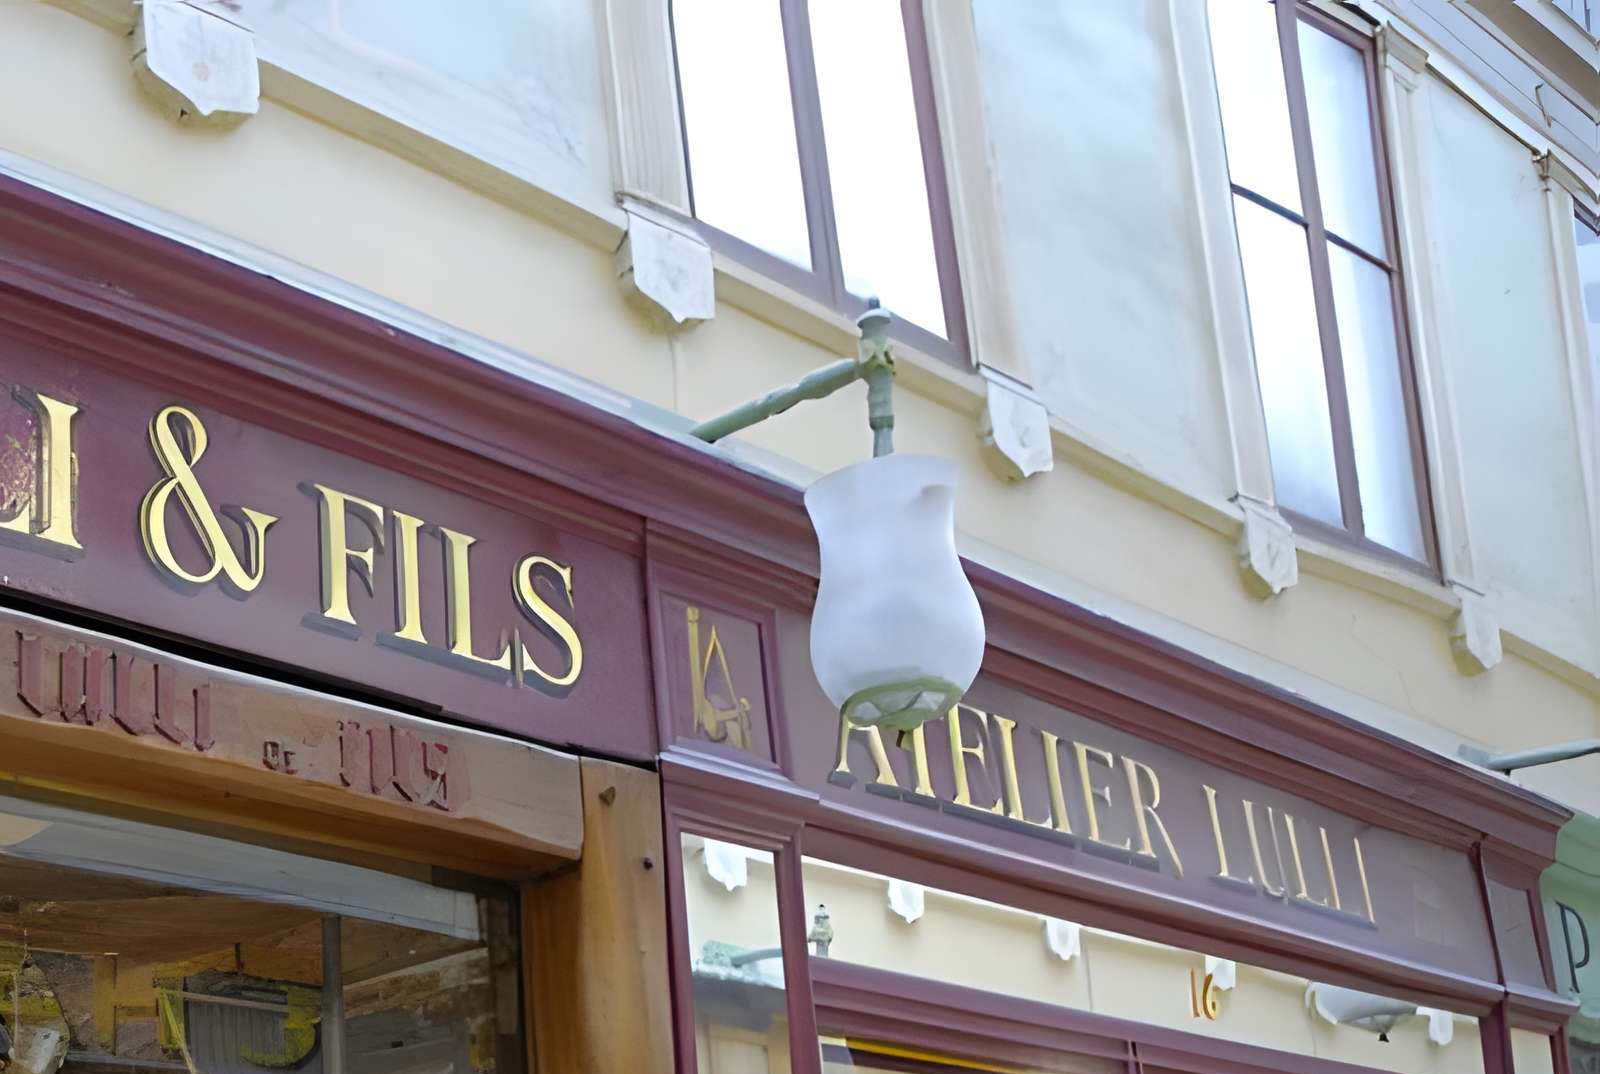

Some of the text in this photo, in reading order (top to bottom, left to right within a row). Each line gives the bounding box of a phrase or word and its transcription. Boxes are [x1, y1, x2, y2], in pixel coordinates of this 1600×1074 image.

[141, 405, 280, 592] &
[313, 484, 584, 687] FILS
[1203, 784, 1376, 925] LULLI
